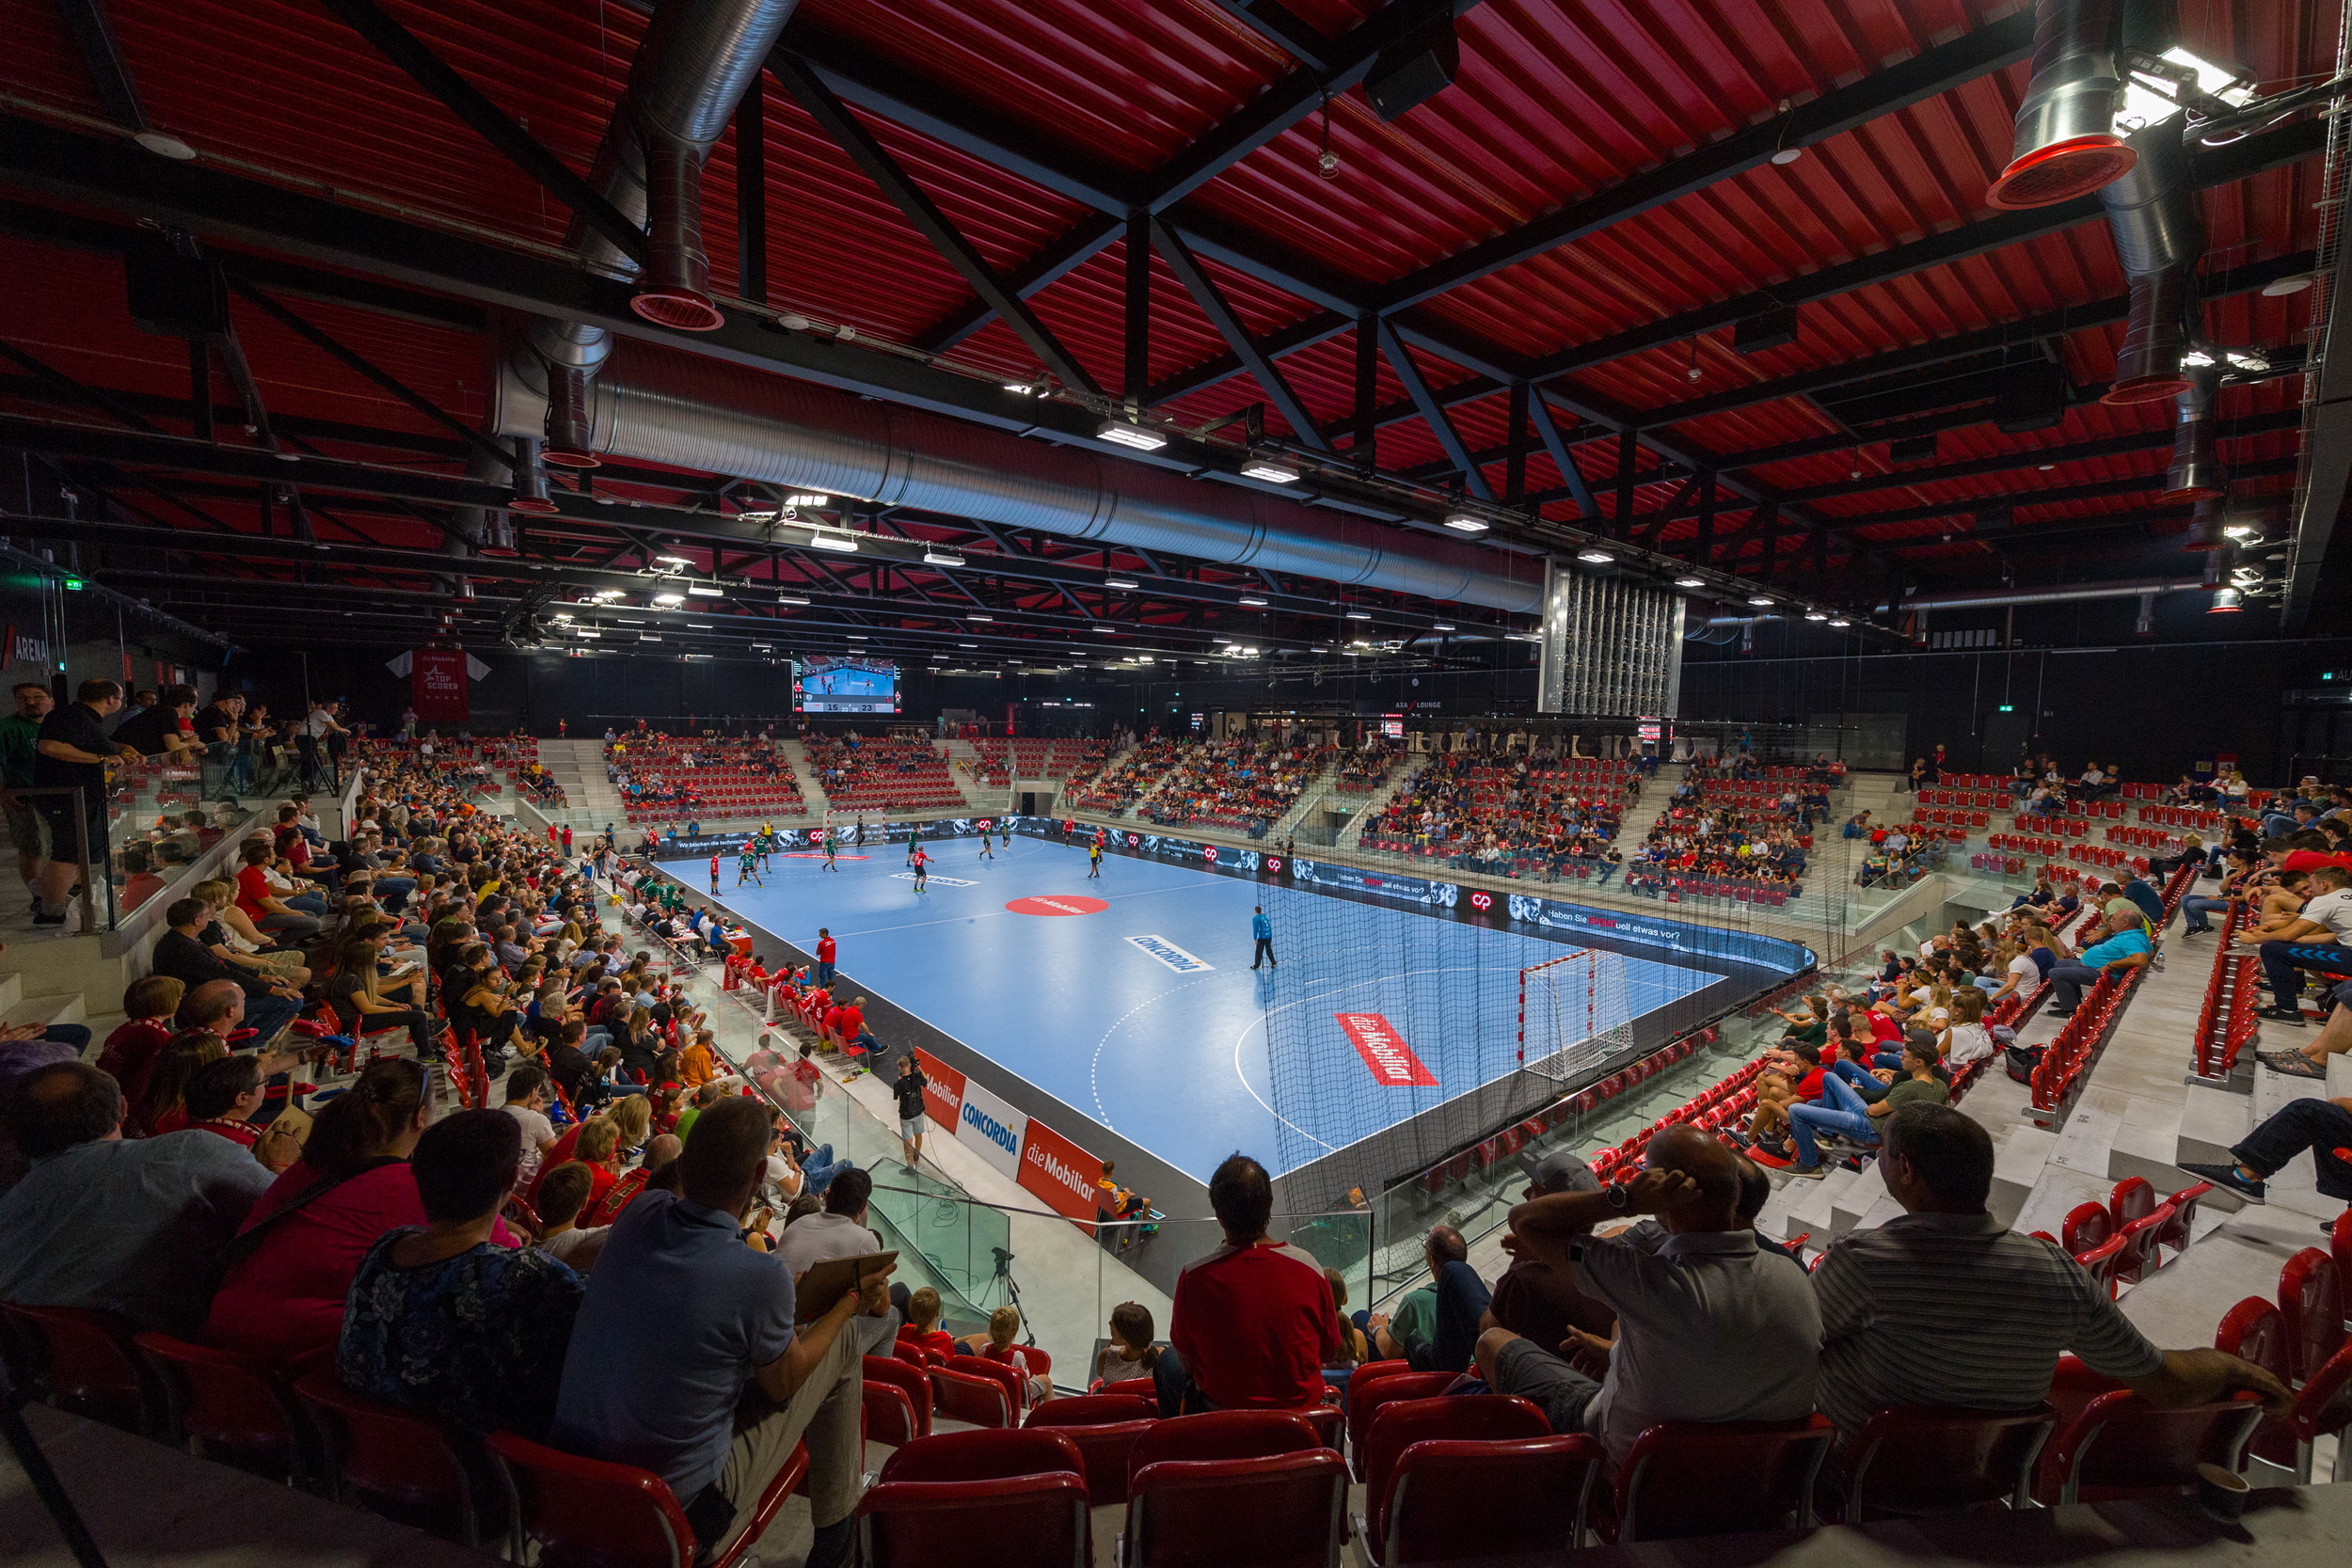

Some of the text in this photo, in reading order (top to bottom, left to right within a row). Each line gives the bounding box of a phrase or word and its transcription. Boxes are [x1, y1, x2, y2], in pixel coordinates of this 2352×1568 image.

[15, 635, 47, 663] ARENA
[426, 682, 458, 690] SCORER
[435, 674, 451, 683] TOP
[1548, 910, 1573, 922] Haben
[1574, 913, 1587, 924] Sie
[1632, 926, 1659, 937] etwas
[1661, 931, 1681, 942] vor?
[1133, 936, 1200, 972] CONCORDIA
[926, 1073, 961, 1109] Mobiliar
[962, 1101, 1017, 1157] CONCORDIA
